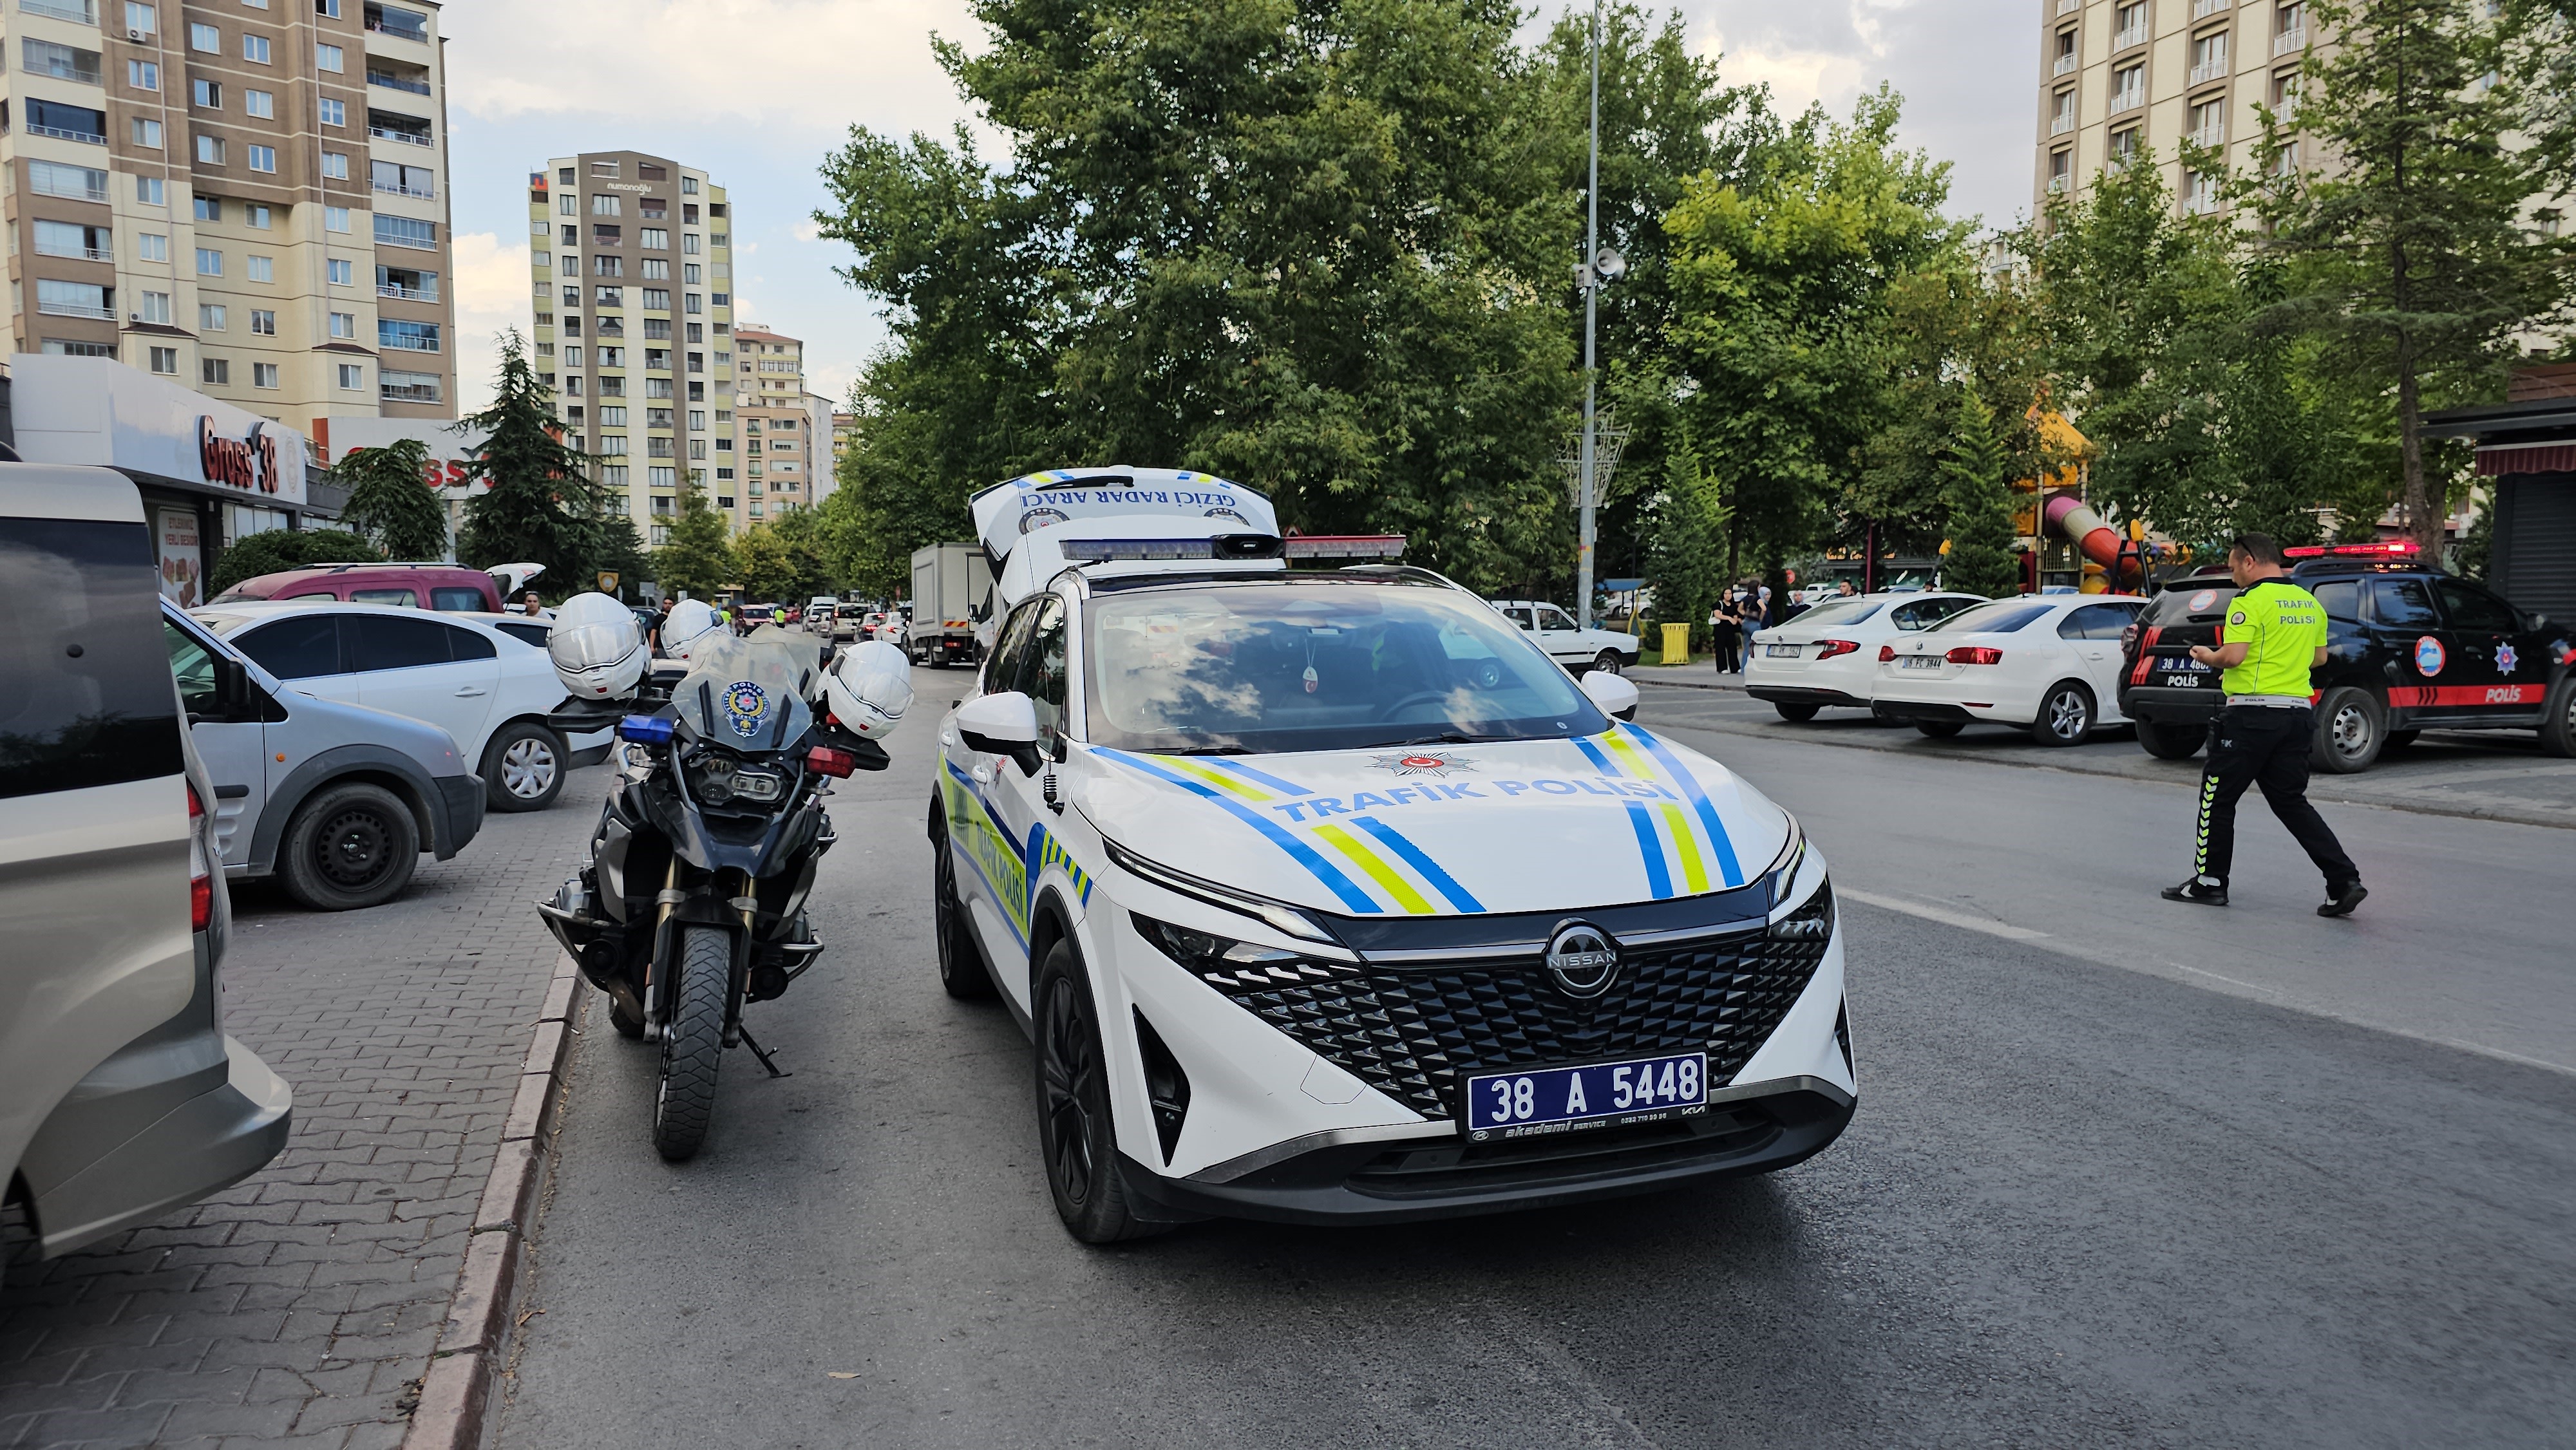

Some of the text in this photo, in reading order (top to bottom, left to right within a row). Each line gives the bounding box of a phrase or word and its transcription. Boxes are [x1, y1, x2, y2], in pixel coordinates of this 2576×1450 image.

[199, 415, 254, 489] Gross
[1021, 491, 1236, 509] GEZİCİ RADAR ARACI
[2275, 599, 2315, 609] TRAFİK
[2280, 615, 2316, 625] POLİSİ
[2162, 657, 2174, 670] 38
[2179, 657, 2184, 669] A
[2167, 673, 2199, 687] POLİS
[2485, 684, 2522, 702] POLİS
[1273, 775, 1679, 823] TRAFİK POLİSİ
[1548, 952, 1616, 968] NISSAN
[1491, 1059, 1699, 1122] 38 A 5448
[1505, 1120, 1572, 1138] akademi
[1573, 1120, 1607, 1131] SERVICE
